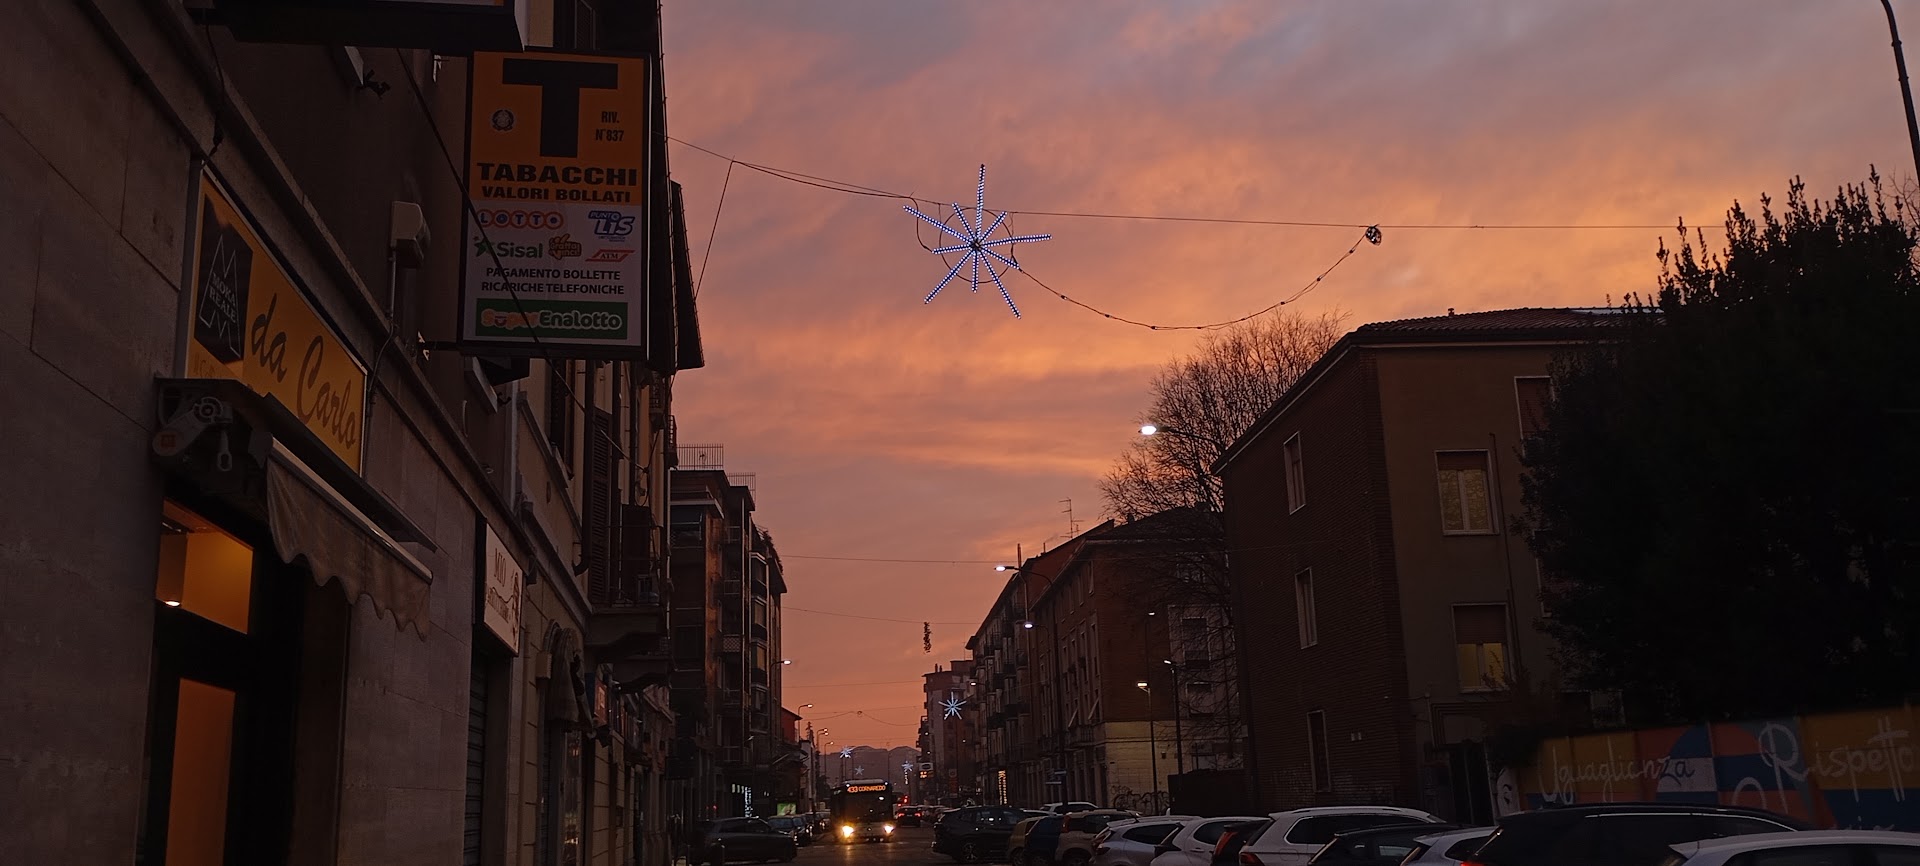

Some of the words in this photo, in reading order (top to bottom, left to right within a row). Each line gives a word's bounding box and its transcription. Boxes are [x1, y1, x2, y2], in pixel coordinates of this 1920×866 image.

[503, 58, 618, 157] T
[601, 111, 620, 124] RIV.
[477, 162, 637, 186] TABACCHI
[482, 186, 549, 199] VALORI
[556, 189, 631, 202] BOLLATI
[479, 210, 560, 227] LOTTO
[496, 242, 543, 258] Sisal
[486, 267, 560, 278] PAGAMENTO
[563, 270, 620, 280] BOLLETTE
[213, 271, 236, 307] MOKA
[481, 282, 543, 292] RICARICHE
[546, 283, 624, 294] TELEFONICHE
[209, 285, 237, 324] REALE
[251, 293, 287, 383] da
[297, 334, 356, 450] Carlo
[1758, 716, 1914, 814] Rispetto
